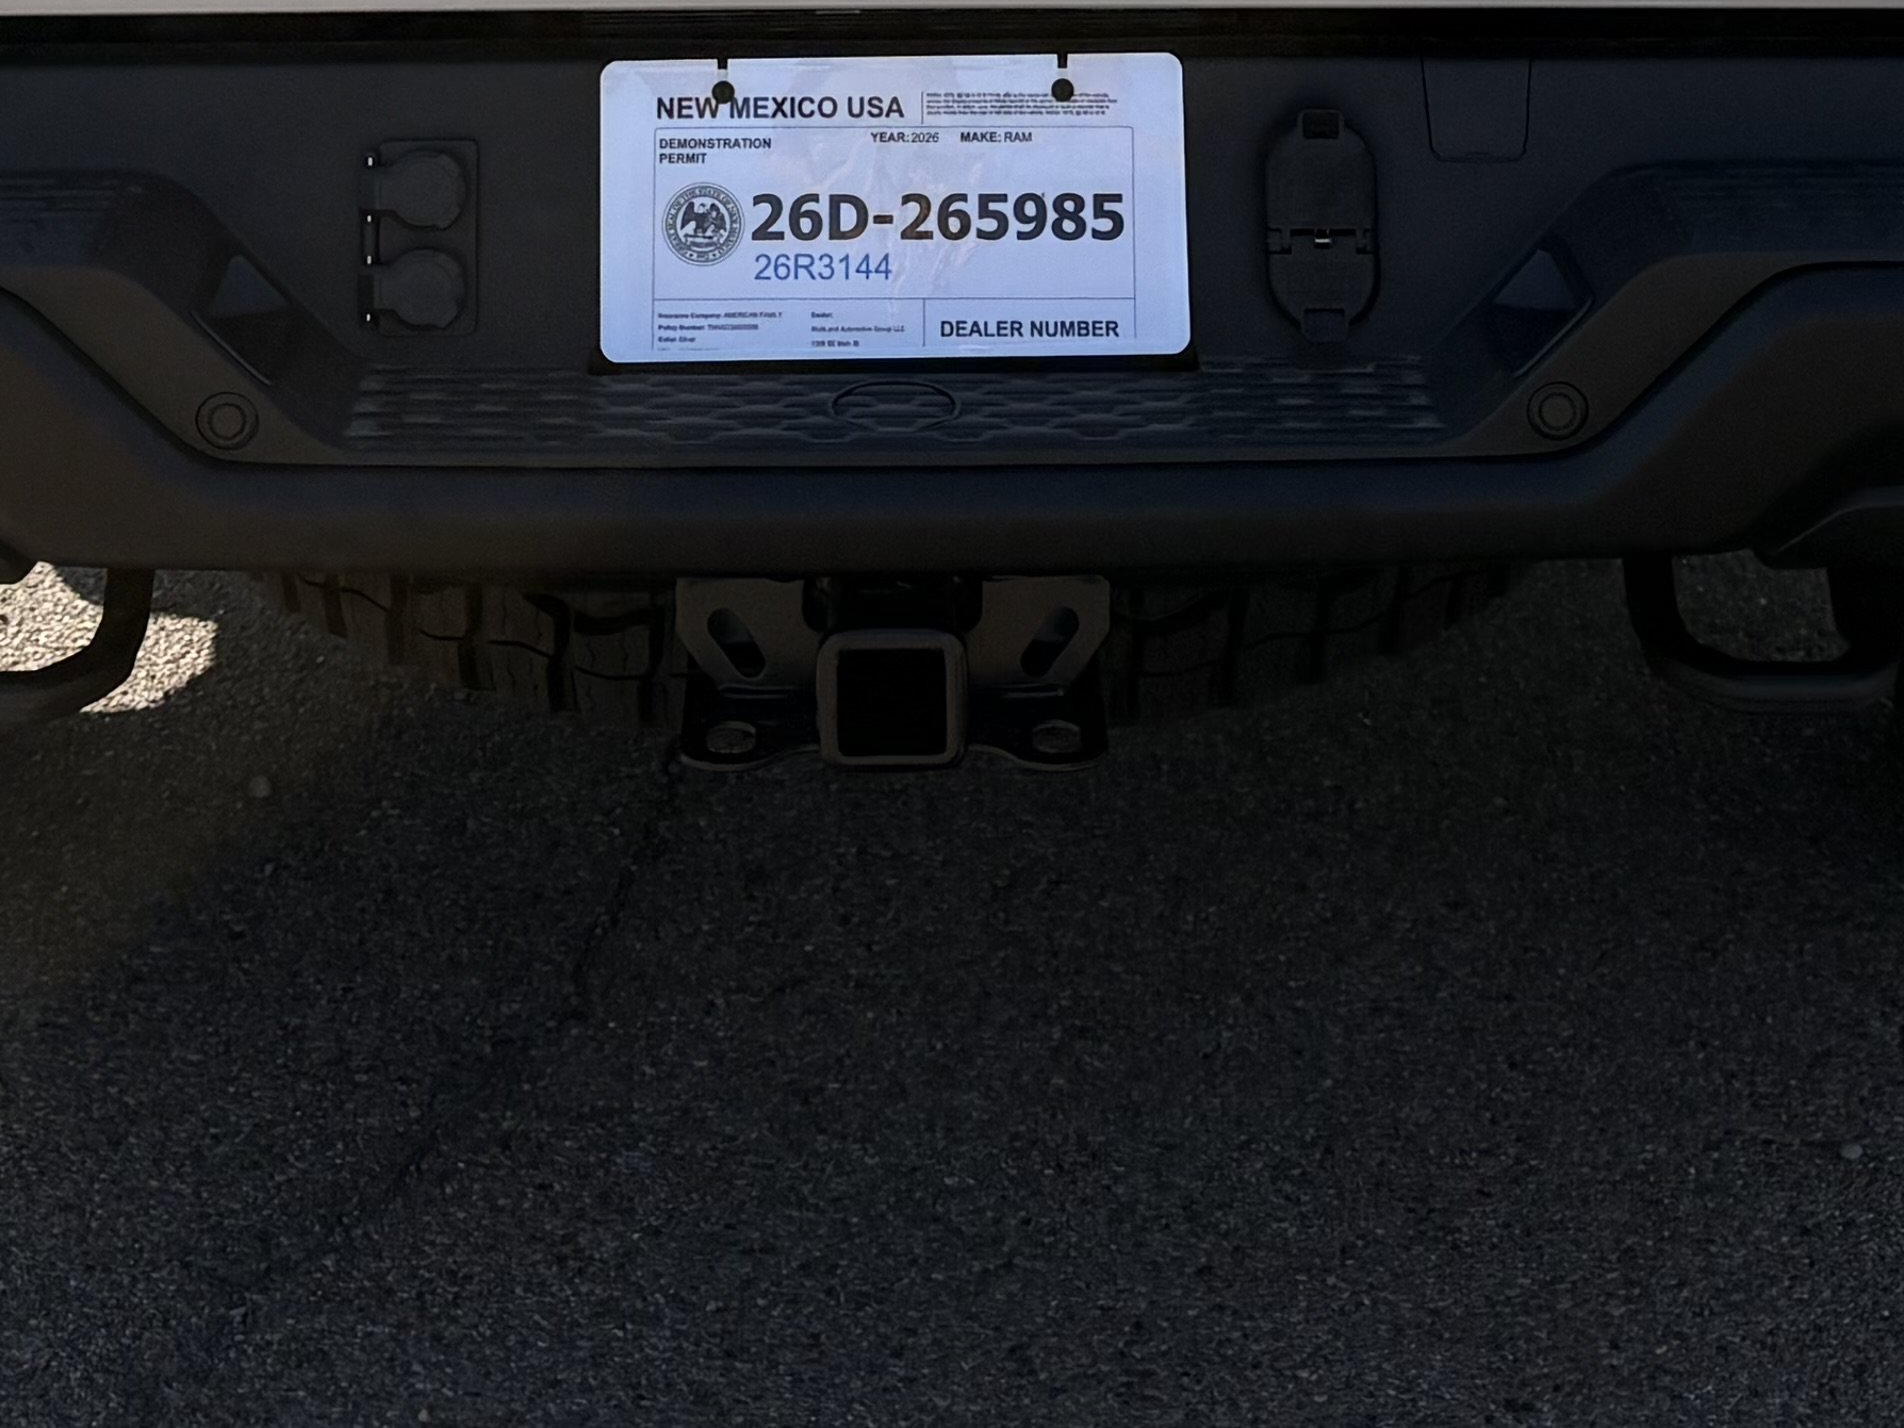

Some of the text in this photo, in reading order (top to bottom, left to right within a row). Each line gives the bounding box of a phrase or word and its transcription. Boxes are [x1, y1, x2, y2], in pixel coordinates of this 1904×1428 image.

[657, 97, 720, 119] NEW
[729, 97, 838, 119] MEXICO
[847, 96, 905, 119] USA
[659, 138, 772, 150] DEMONSTRATION
[871, 132, 1033, 143] YEAR: 2026 MAKE: RAM
[659, 153, 708, 164] PERMIT
[752, 193, 1125, 242] 26D-265985
[754, 253, 893, 281] 26R3144
[940, 320, 1120, 338] DEALER NUMBER
